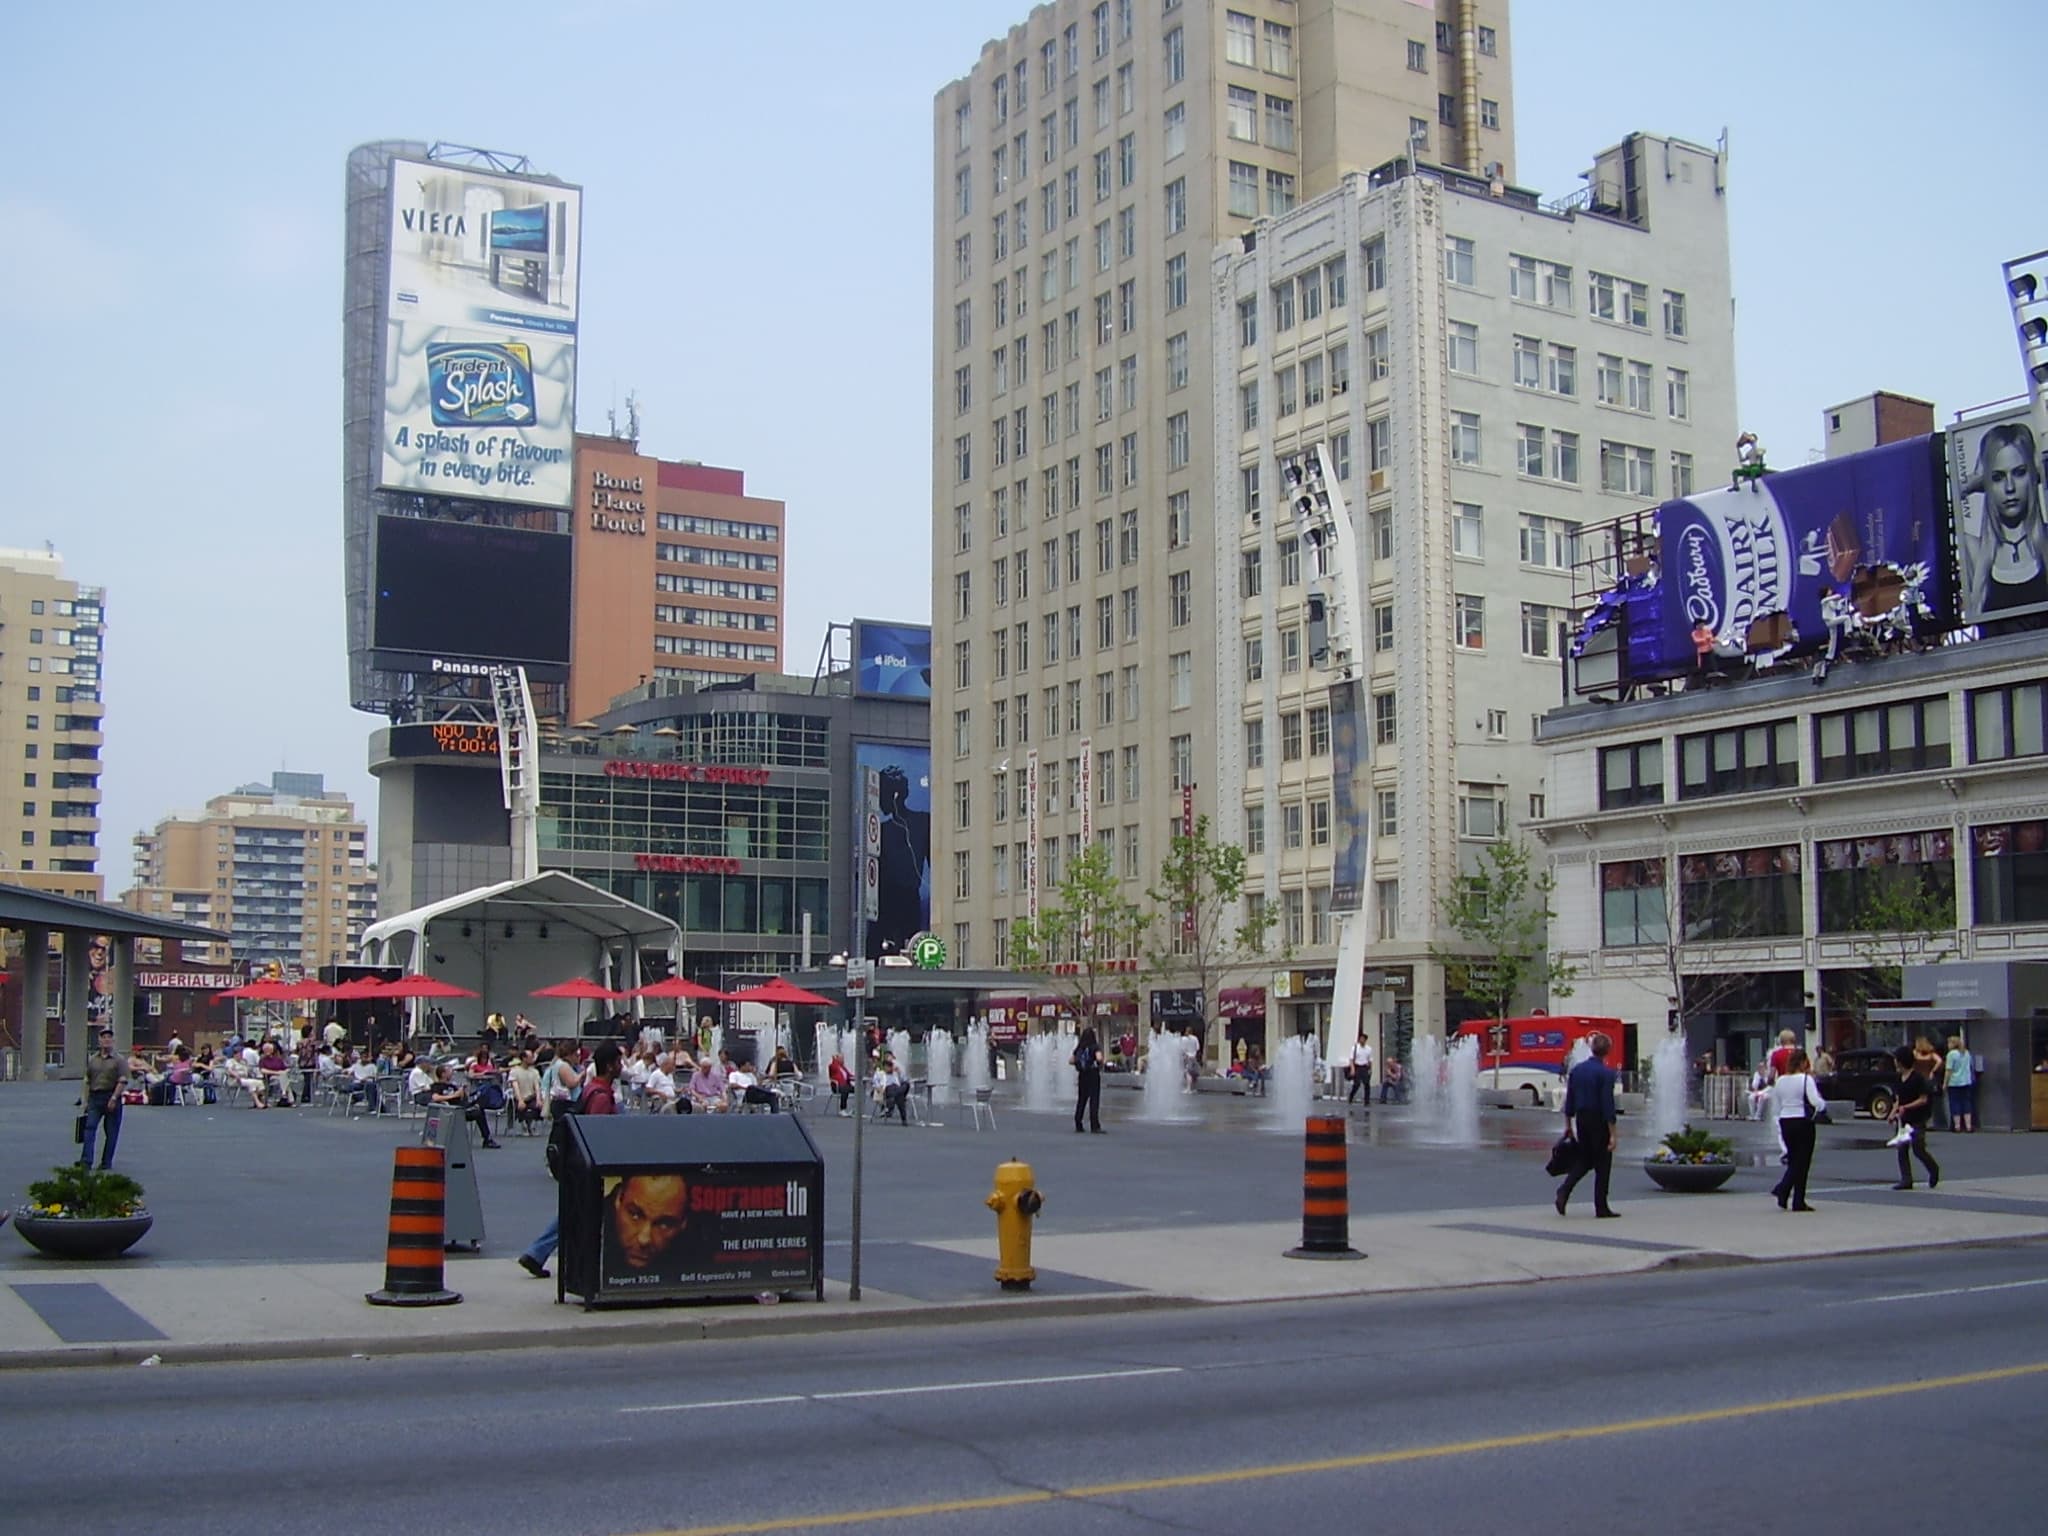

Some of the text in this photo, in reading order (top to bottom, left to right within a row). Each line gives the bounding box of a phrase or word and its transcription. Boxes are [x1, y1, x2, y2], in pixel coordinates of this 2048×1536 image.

[440, 358, 506, 375] Trident
[439, 366, 524, 416] Splash
[395, 425, 563, 463] A splash of flavour
[419, 455, 535, 487] in every bite.
[1957, 437, 1969, 484] LAVIGNE
[593, 471, 643, 494] Bond
[592, 492, 646, 514] Place
[591, 512, 646, 536] Hotel
[1723, 515, 1755, 626] DAIRY
[1751, 514, 1778, 609] MILK
[1686, 533, 1718, 630] Cadbury
[883, 655, 907, 668] iPod
[433, 725, 494, 738] NOV 17
[438, 738, 498, 753] 7:00:4
[604, 760, 697, 781] OLYMPIC
[1029, 762, 1037, 852] JEWELLERY
[1082, 750, 1090, 845] JEWELLERY
[634, 853, 741, 874] TORONTO
[924, 943, 939, 961] P
[141, 972, 244, 988] IMPERIAL PUB
[1172, 992, 1182, 1007] 21
[786, 1180, 808, 1217] tln
[721, 1210, 739, 1218] HAVE
[740, 1210, 746, 1219] A
[764, 1209, 784, 1217] HOME
[722, 1236, 808, 1250] THE ENTIRE SERIES
